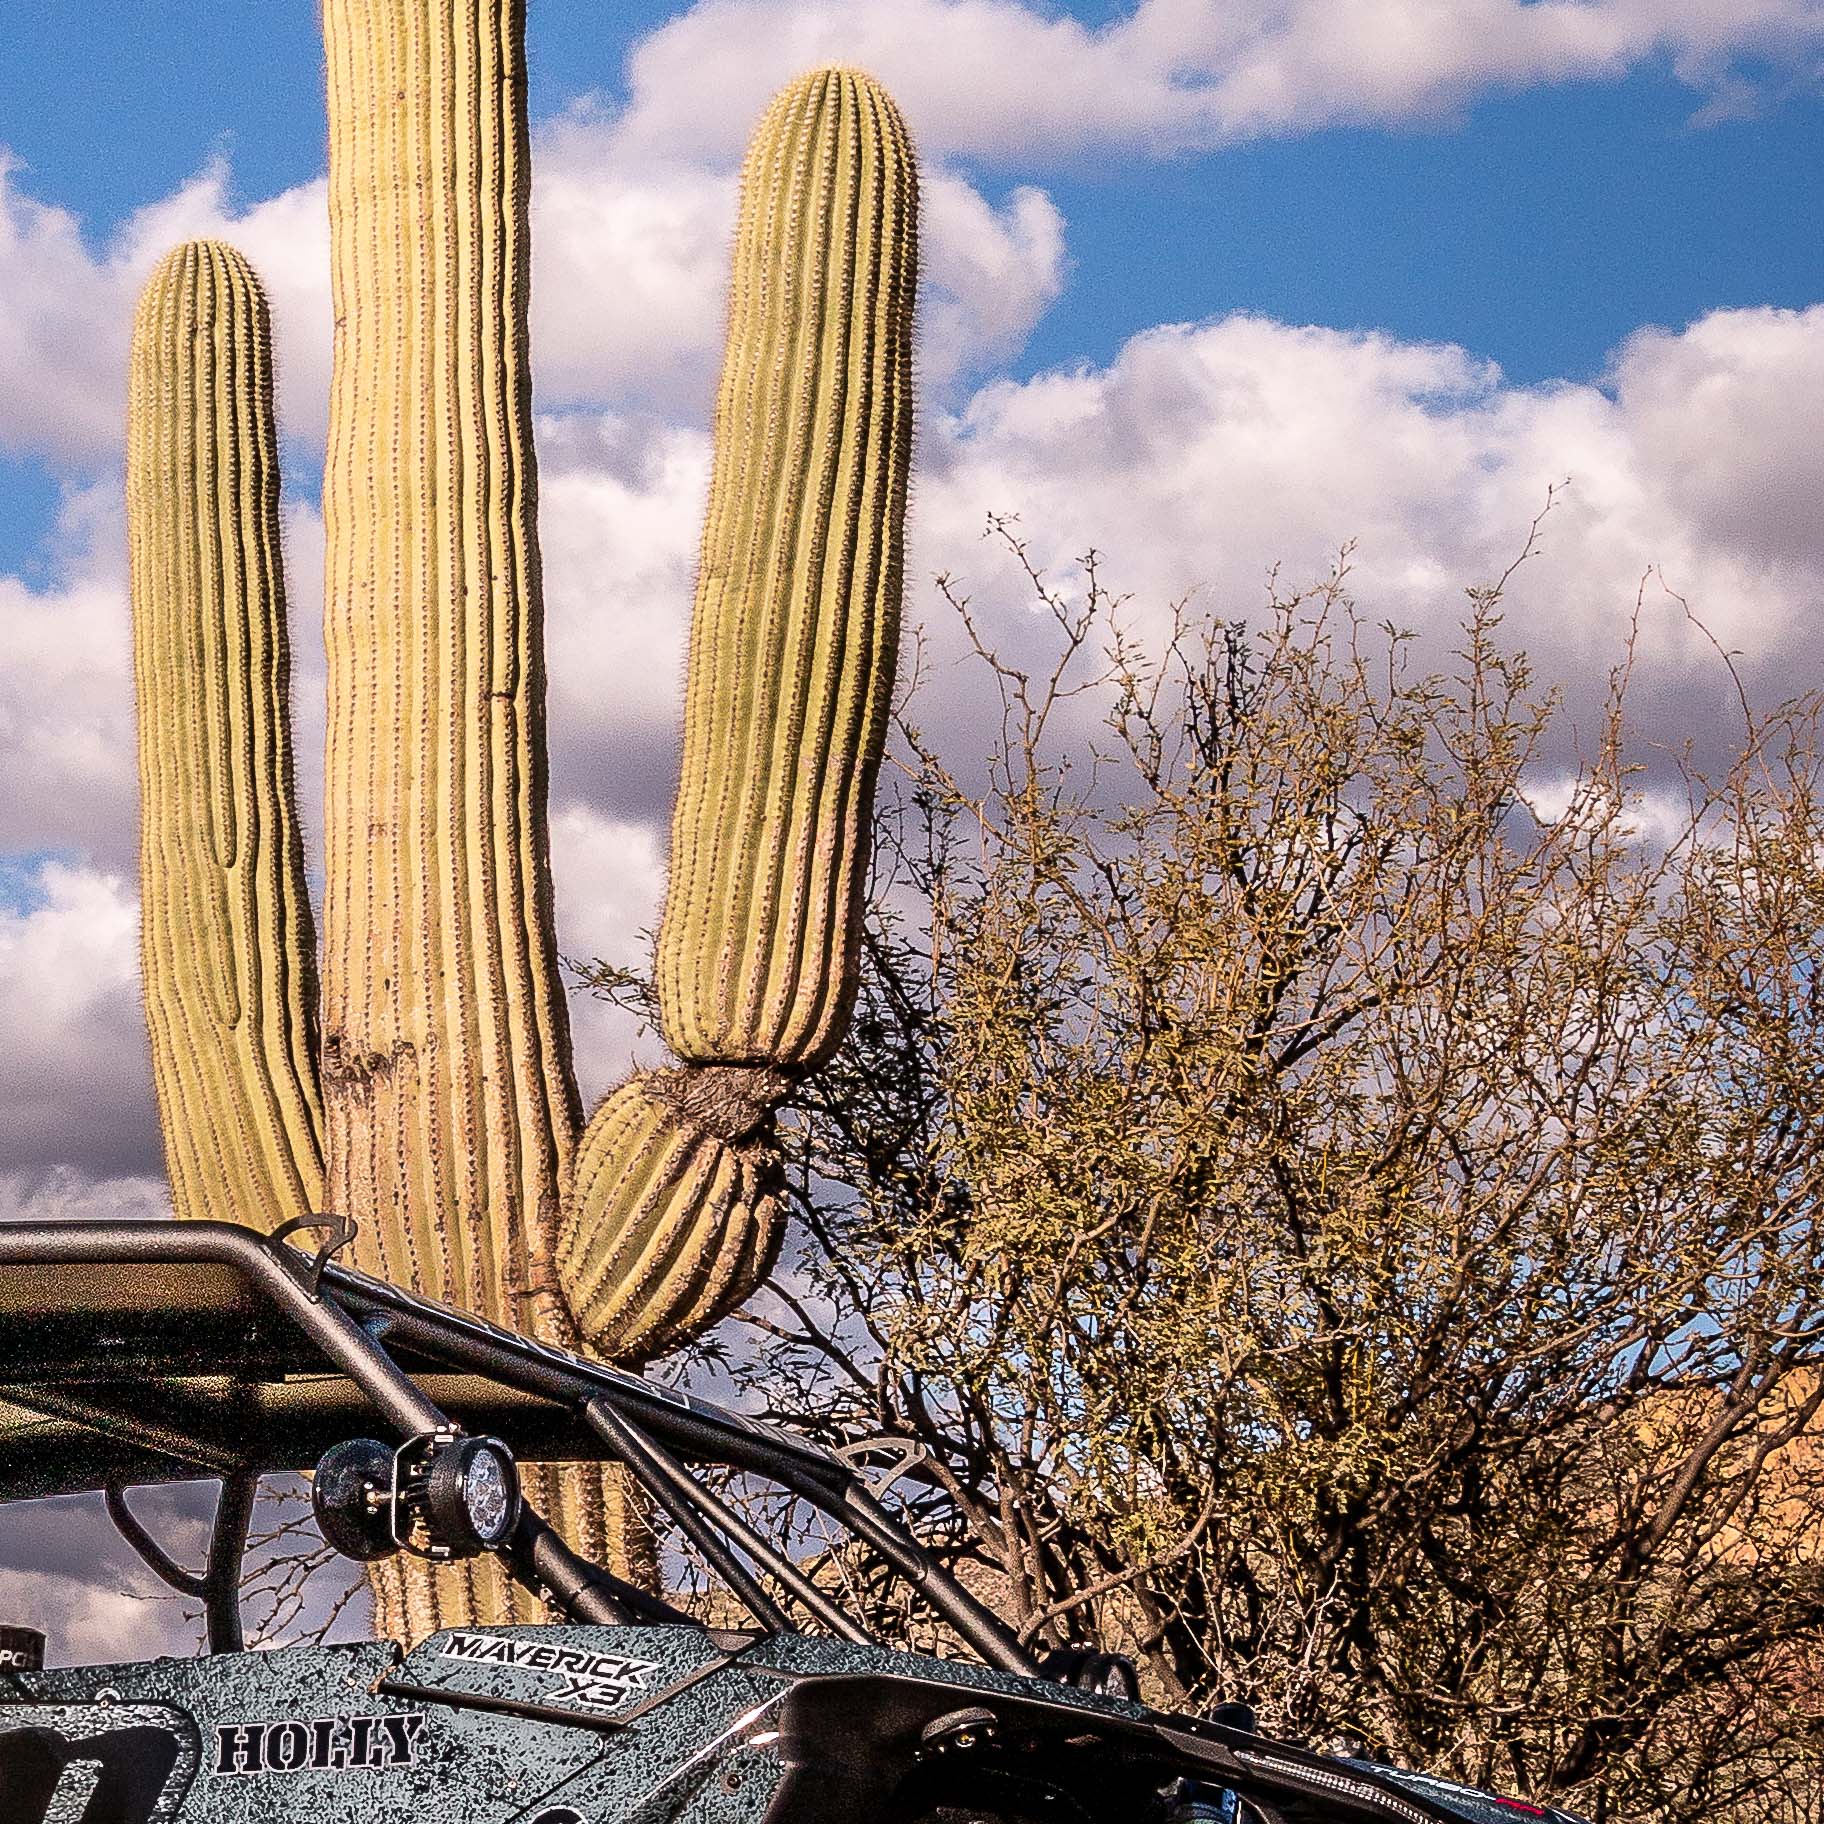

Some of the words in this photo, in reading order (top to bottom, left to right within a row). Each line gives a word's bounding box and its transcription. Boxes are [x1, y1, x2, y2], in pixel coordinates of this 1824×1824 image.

[444, 1634, 652, 1685] MAVERICK
[554, 1676, 626, 1707] X3
[215, 1713, 425, 1775] HOLLY
